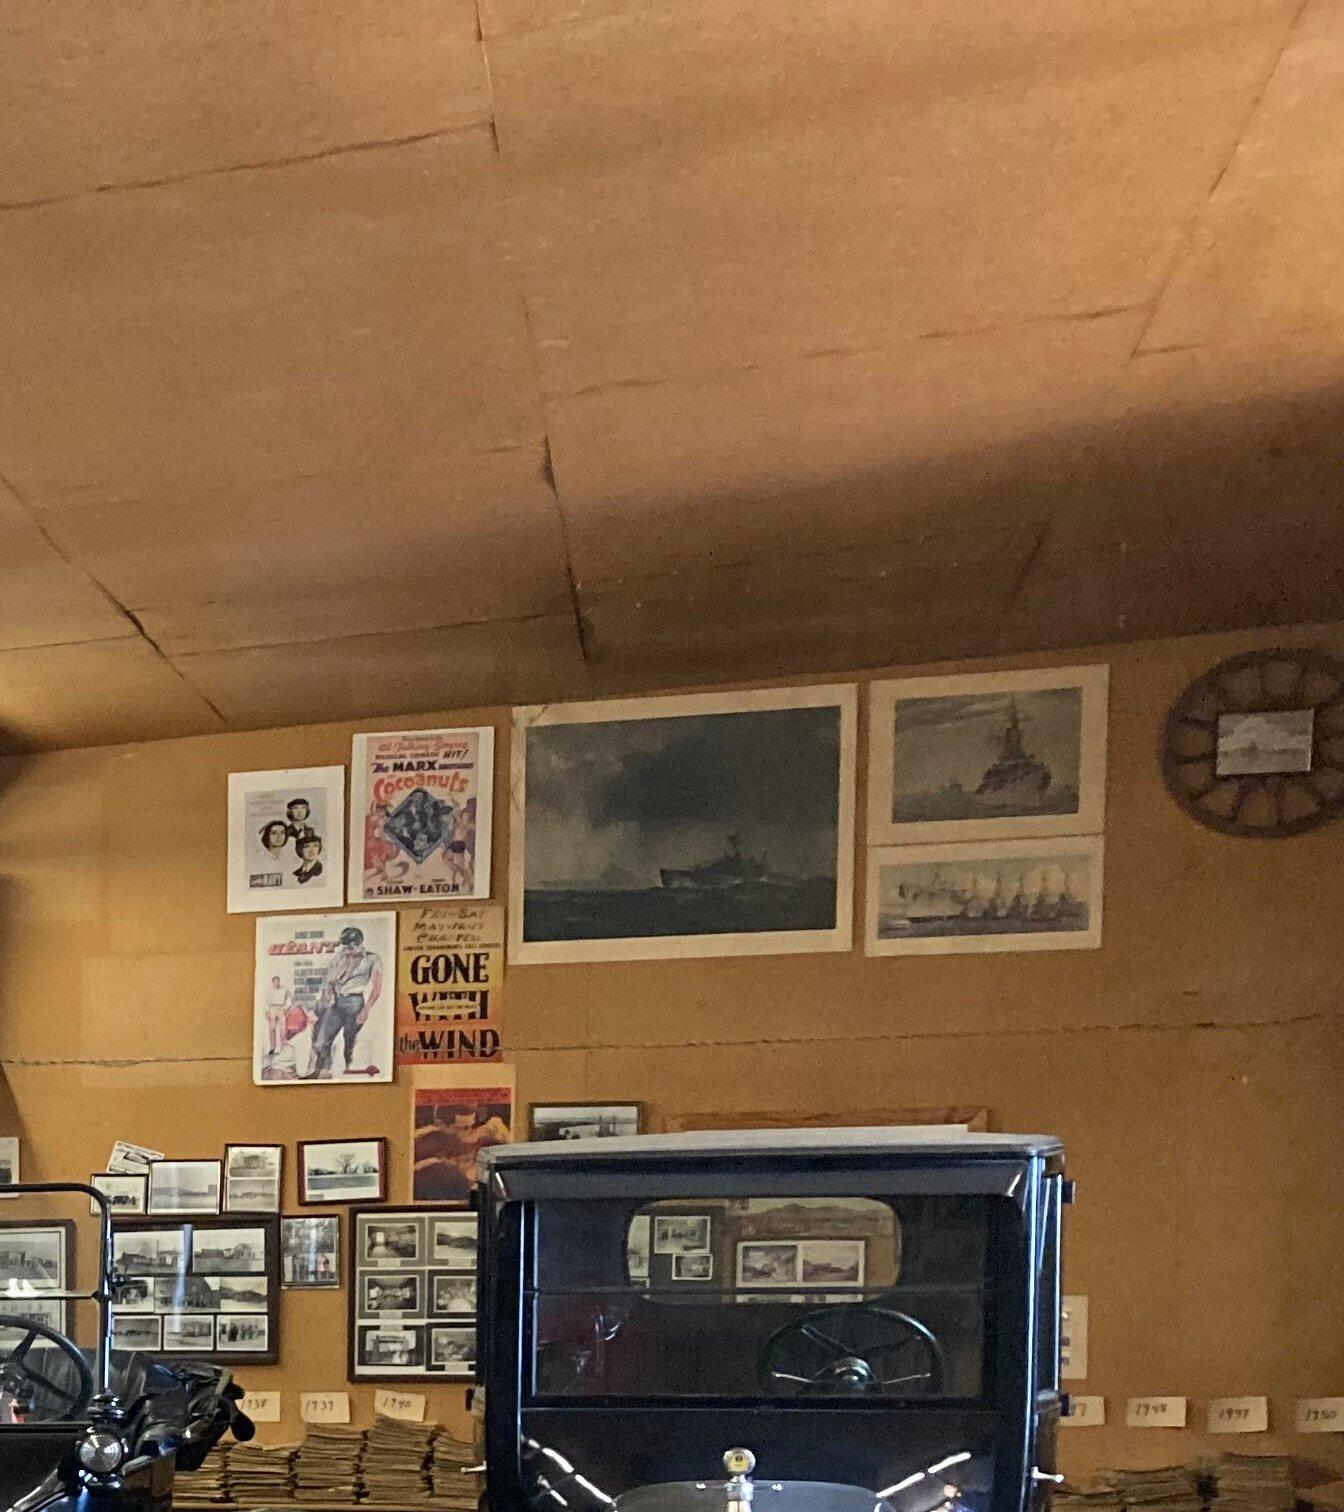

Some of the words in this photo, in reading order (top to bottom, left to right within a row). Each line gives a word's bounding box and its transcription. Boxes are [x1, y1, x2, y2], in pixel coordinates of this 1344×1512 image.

[392, 760, 438, 772] MARX
[373, 772, 470, 803] Cocoanuts
[377, 884, 413, 896] SHAW
[419, 883, 460, 894] EATON
[411, 952, 490, 985] GONE
[407, 990, 489, 1022] WITH
[418, 1028, 500, 1060] WIND
